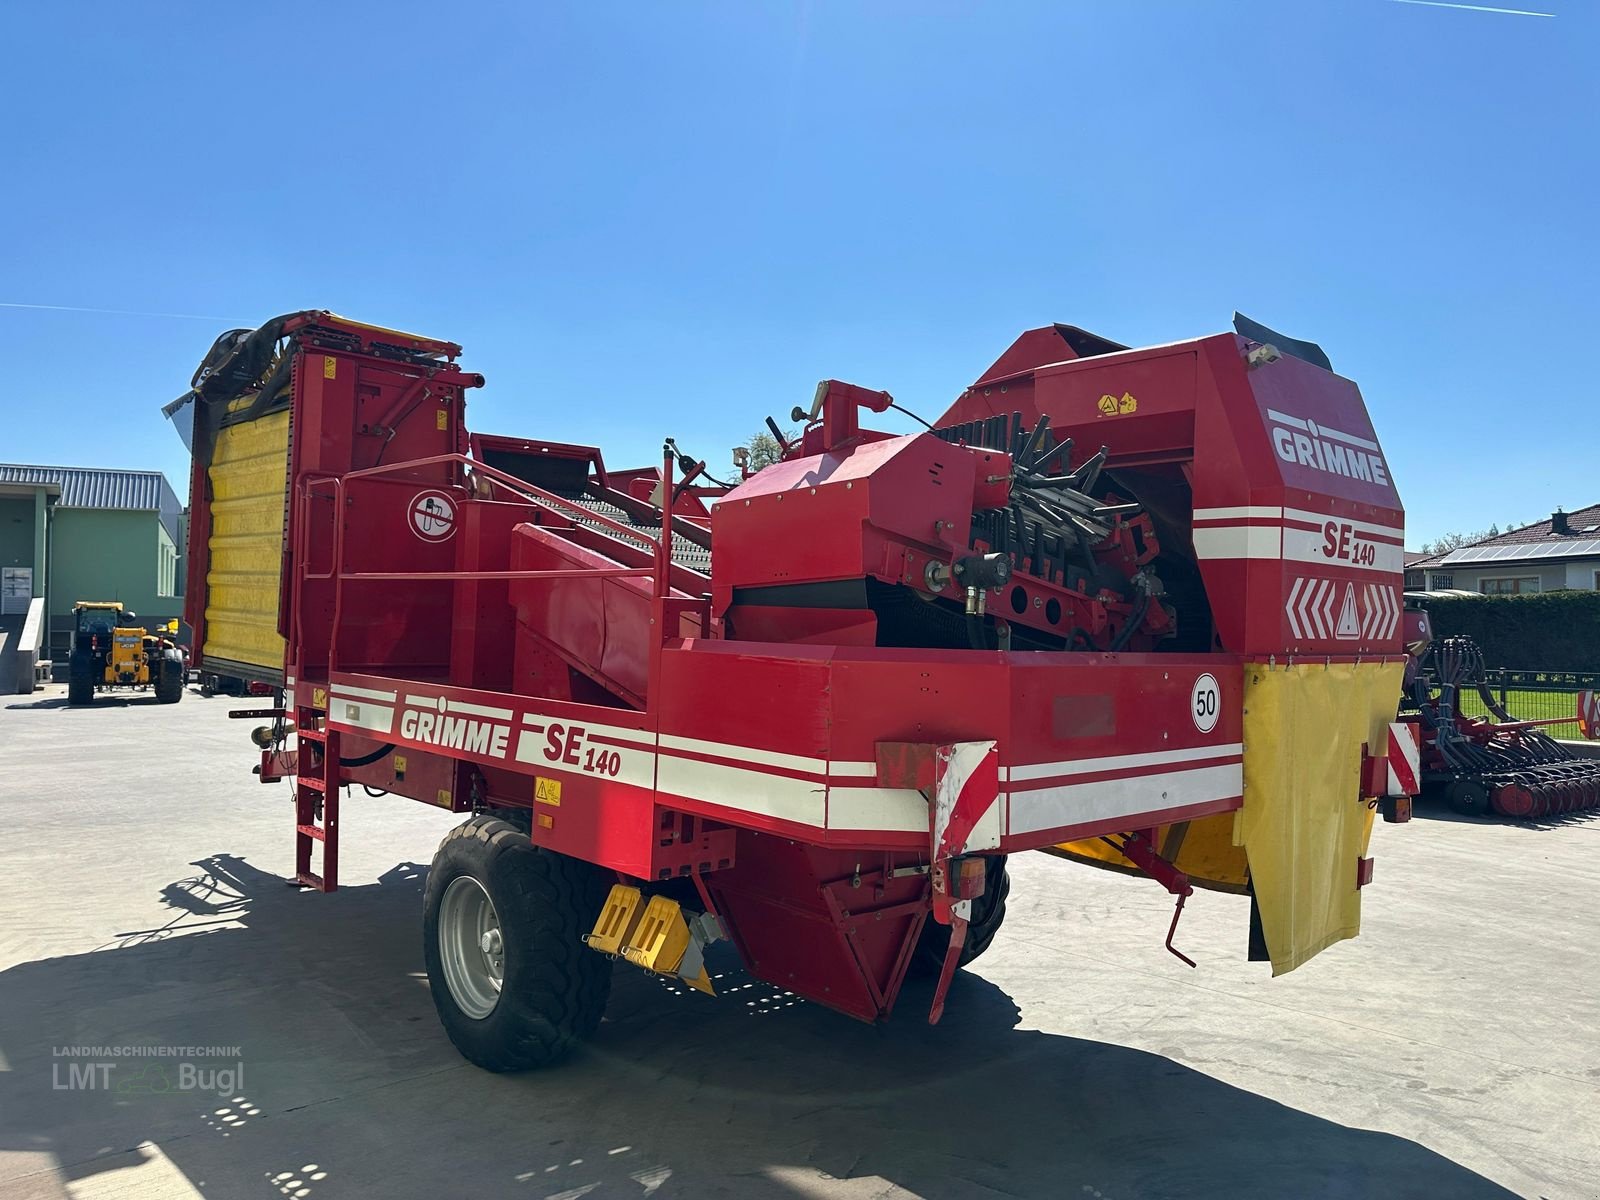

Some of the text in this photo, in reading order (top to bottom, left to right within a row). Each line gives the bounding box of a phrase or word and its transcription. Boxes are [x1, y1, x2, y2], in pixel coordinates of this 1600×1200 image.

[1272, 419, 1388, 486] GRIMME
[1322, 521, 1375, 566] SE 140
[400, 696, 510, 759] GRIMME
[1196, 689, 1216, 717] 50
[543, 724, 620, 776] SE 140
